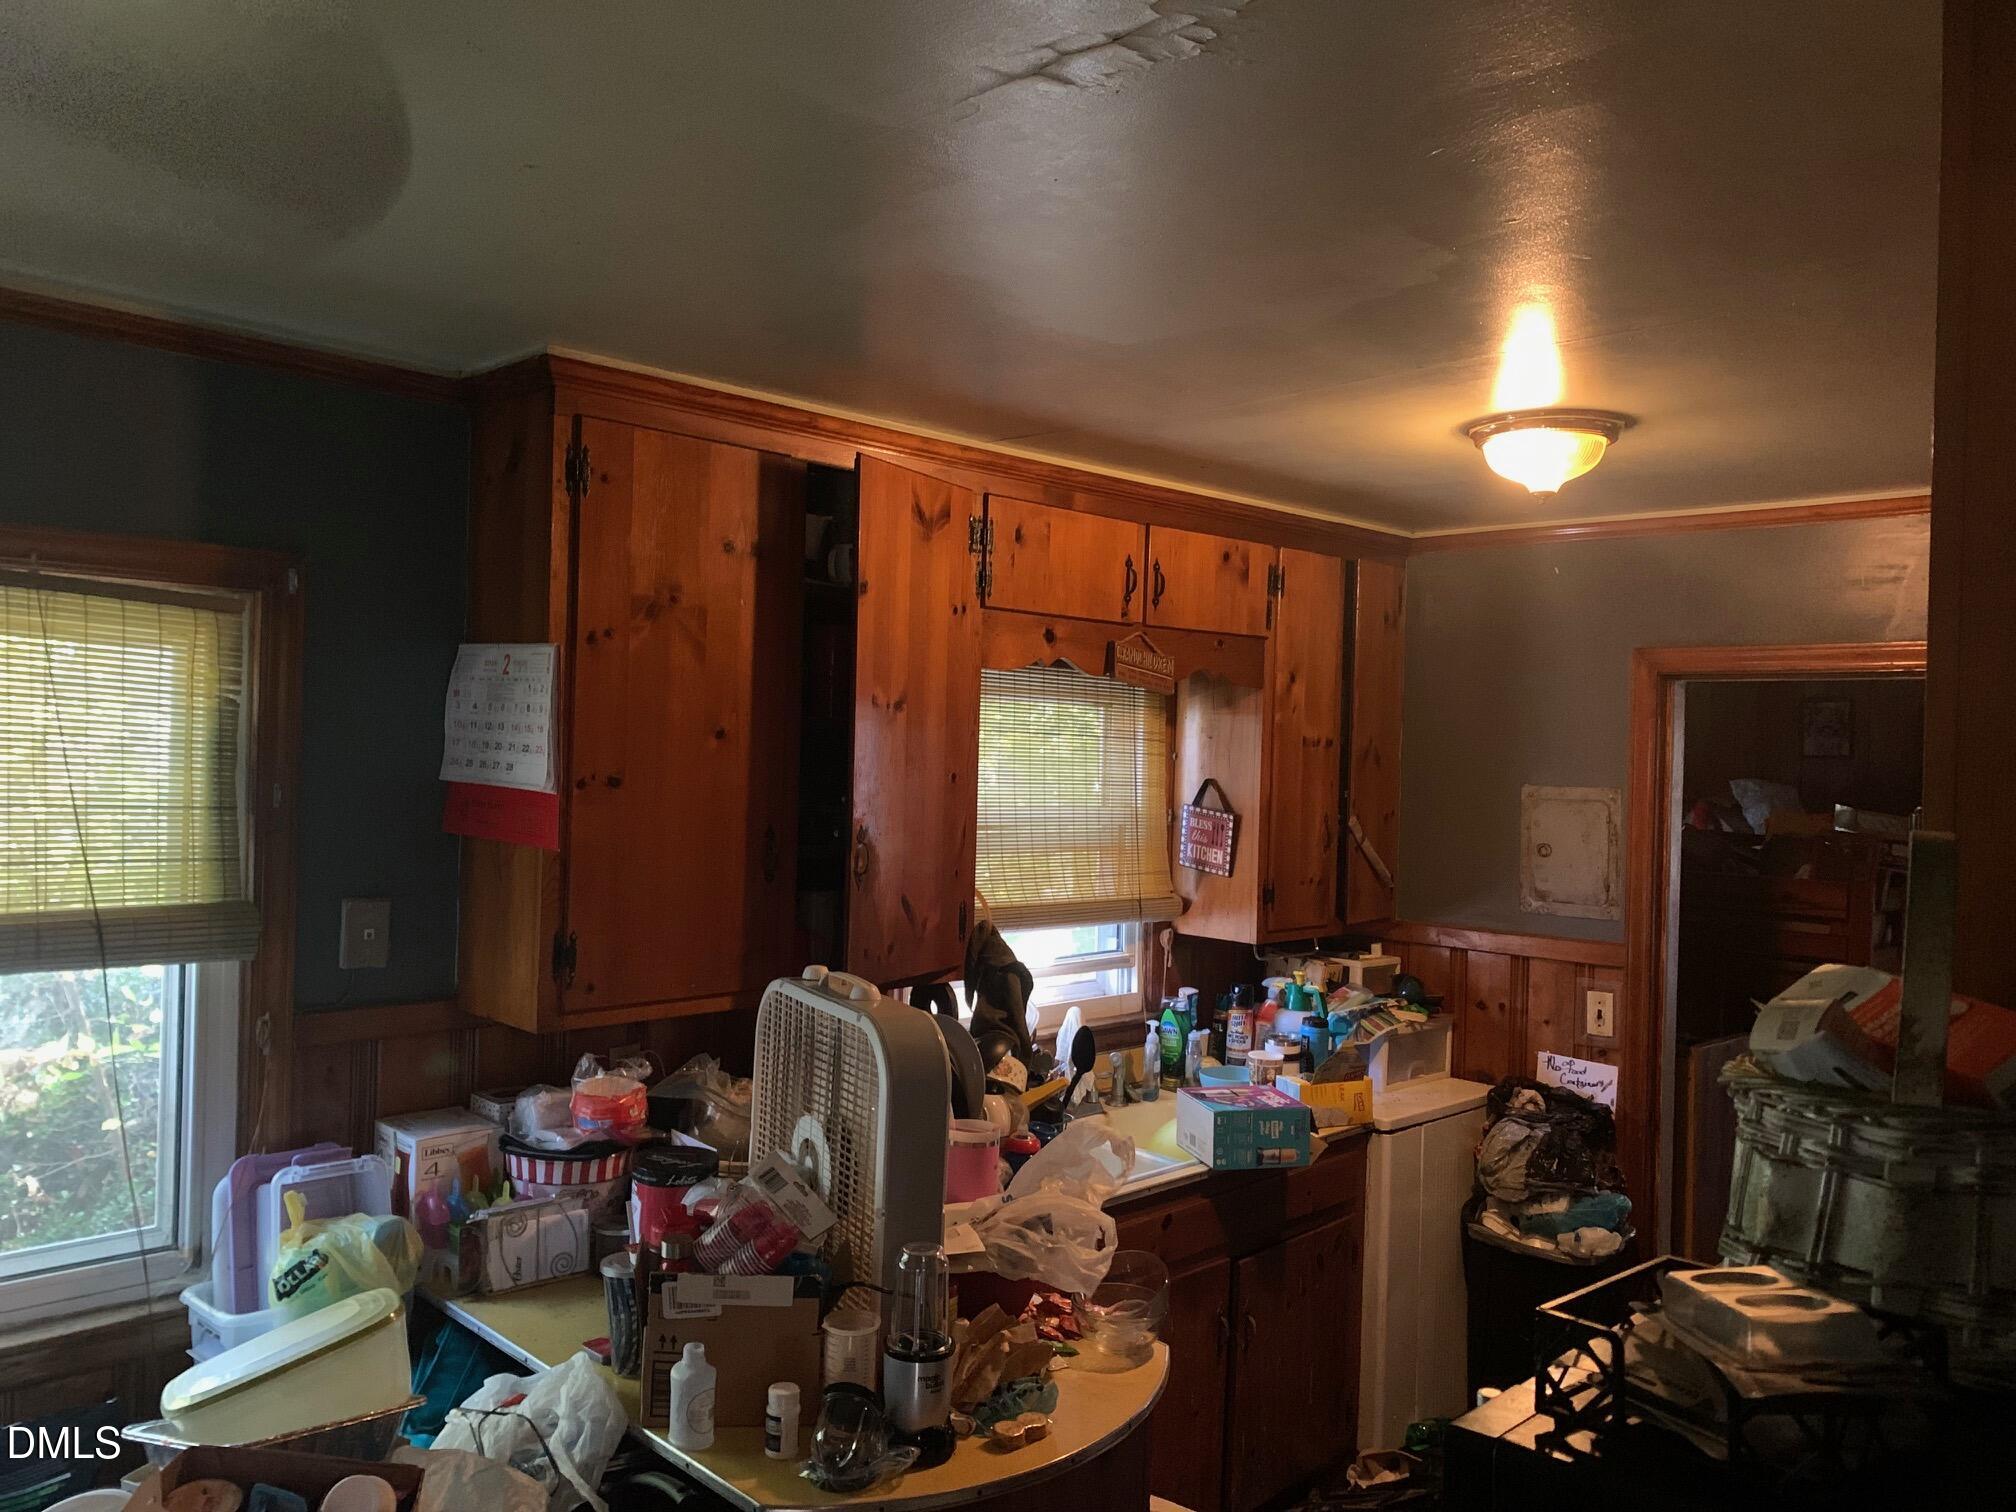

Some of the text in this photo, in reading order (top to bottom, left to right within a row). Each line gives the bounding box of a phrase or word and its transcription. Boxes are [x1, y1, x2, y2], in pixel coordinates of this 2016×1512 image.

[502, 654, 511, 676] 2
[469, 721, 477, 729] 11
[484, 722, 492, 730] 12
[497, 723, 504, 731] 13
[494, 742, 503, 751] 20
[508, 743, 516, 751] 21
[521, 744, 530, 752] 22
[1189, 817, 1213, 831] BLESS
[1186, 842, 1224, 865] KITCHEN
[1545, 1055, 1562, 1072] No
[424, 1162, 438, 1176] 4
